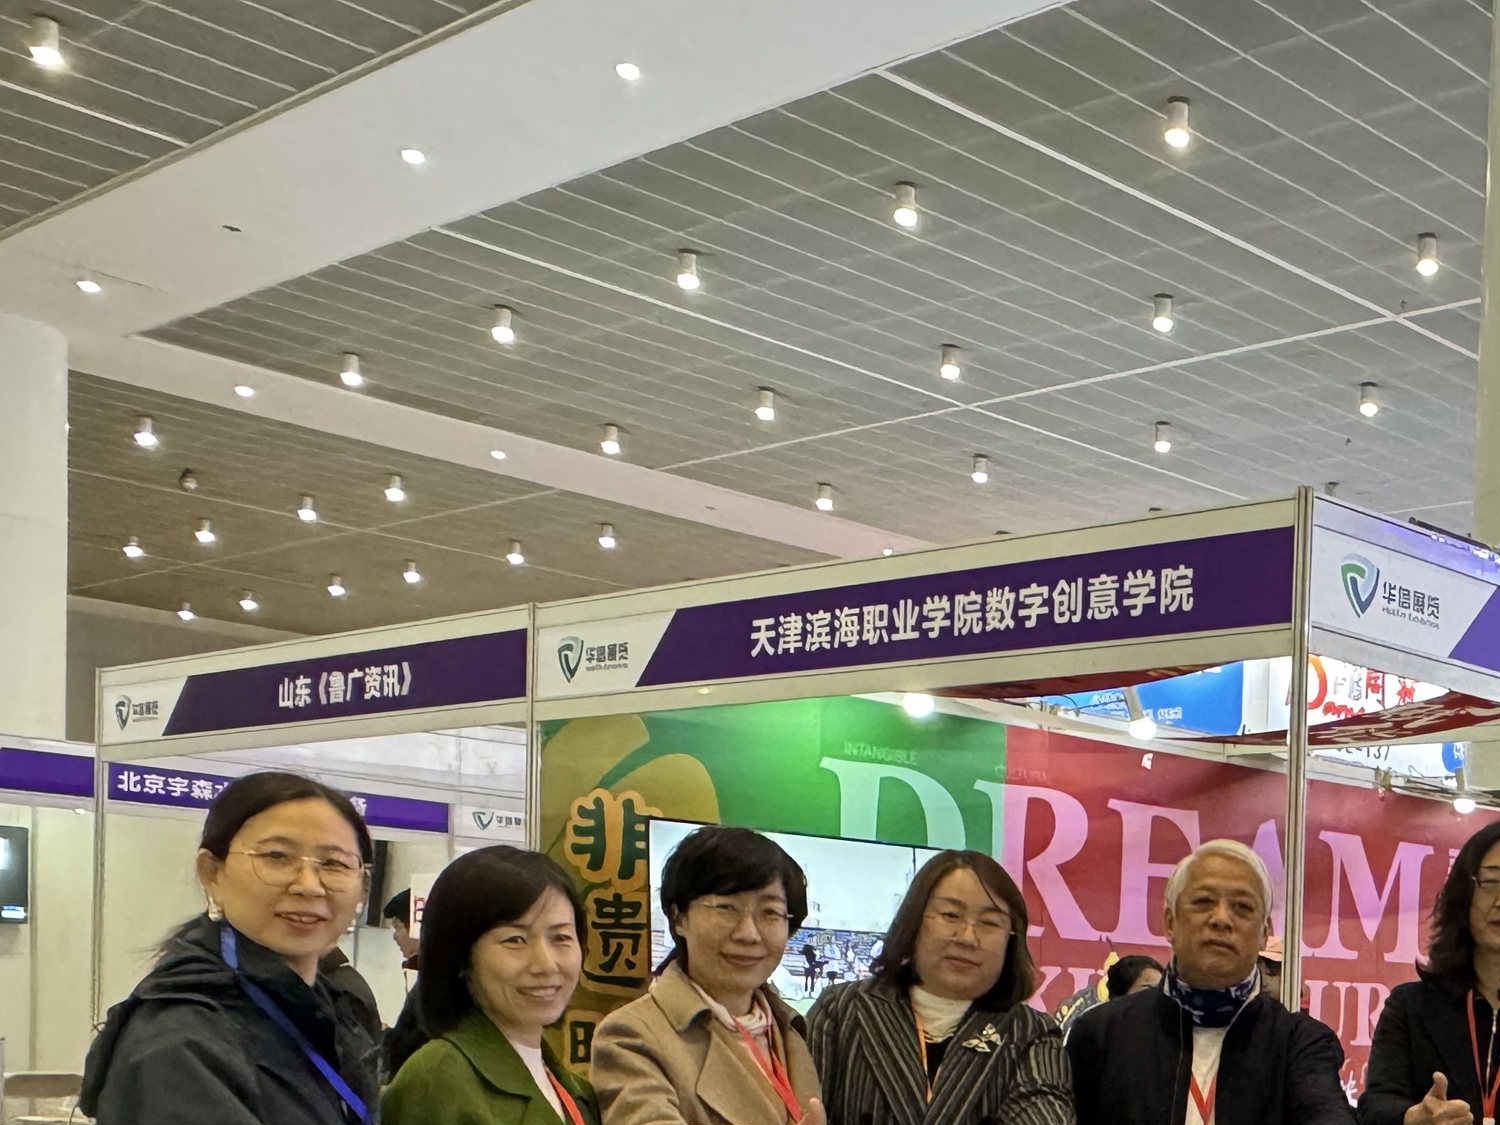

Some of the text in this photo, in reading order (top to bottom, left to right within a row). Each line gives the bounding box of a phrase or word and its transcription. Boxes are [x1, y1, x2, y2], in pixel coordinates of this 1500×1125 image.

[749, 564, 1194, 658] 天津滨海职业学院数字创意学院
